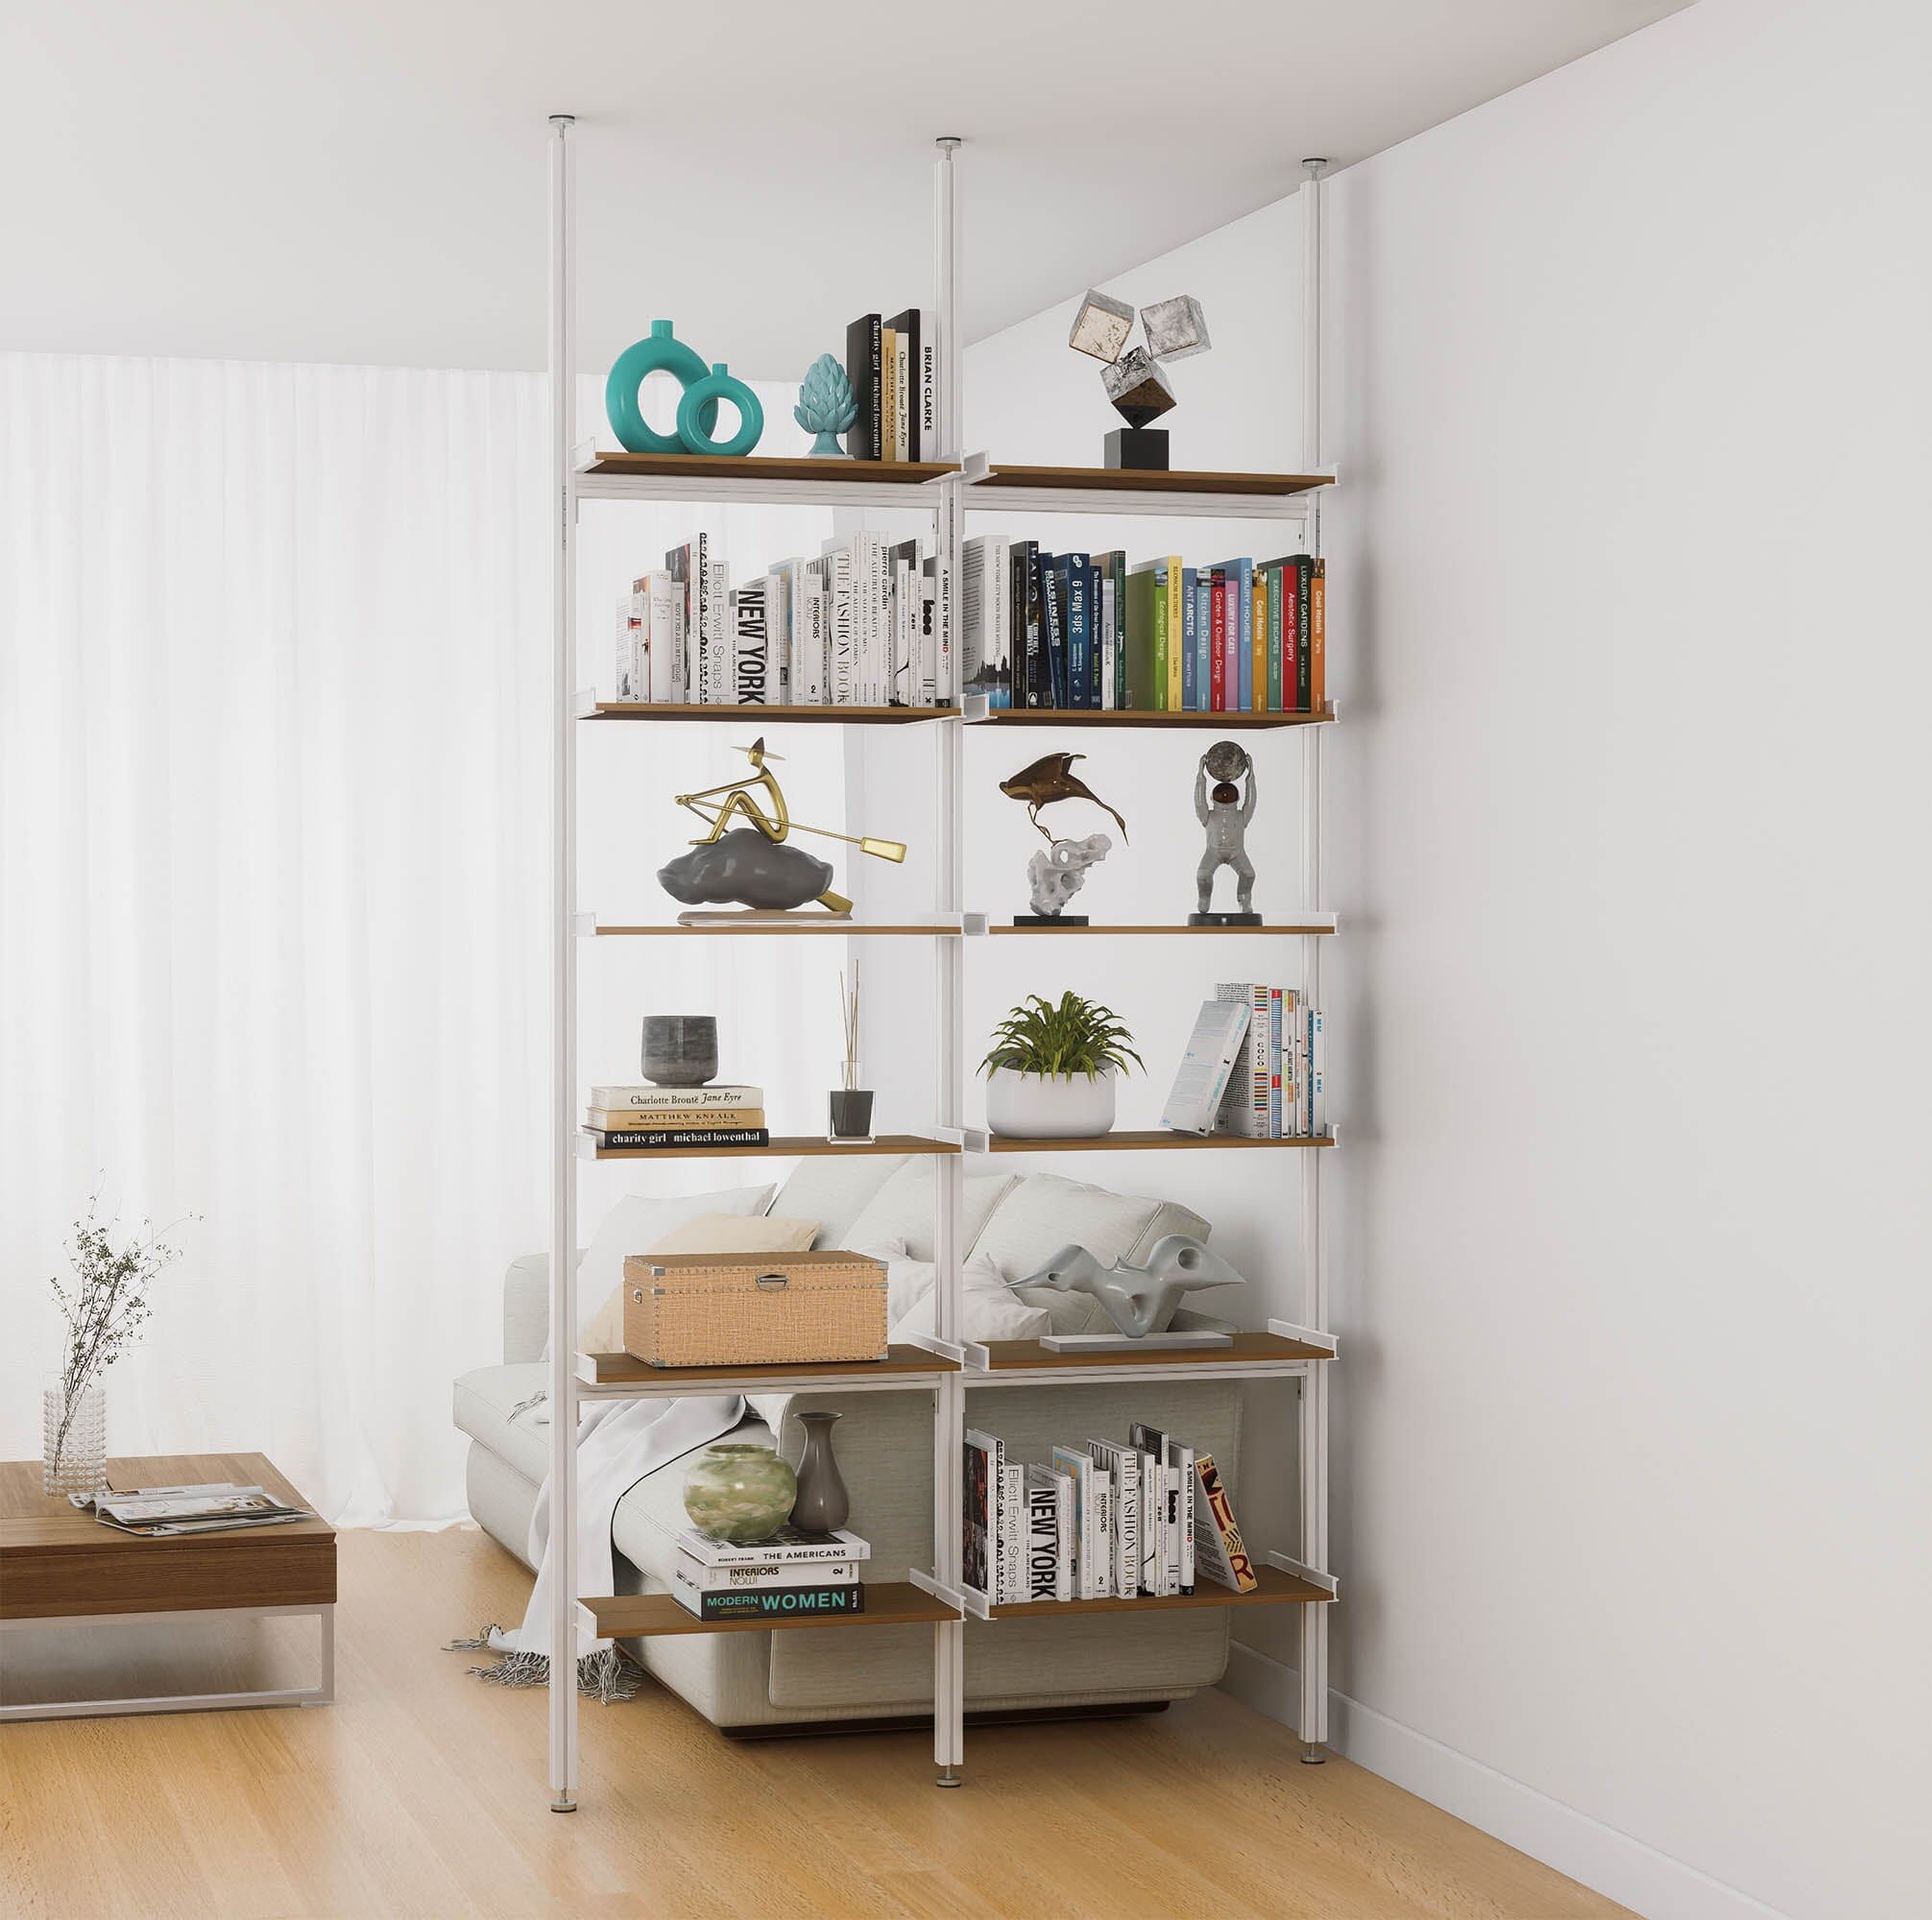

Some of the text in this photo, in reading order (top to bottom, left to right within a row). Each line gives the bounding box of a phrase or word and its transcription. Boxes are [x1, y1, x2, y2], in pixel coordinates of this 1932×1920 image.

[872, 593, 878, 603] OF
[943, 603, 949, 612] IN
[1049, 569, 1060, 647] BUSINESS
[1072, 589, 1083, 612] Max
[1214, 591, 1222, 616] Garden
[712, 564, 724, 690] Elliott Erwitt Snaps
[837, 553, 850, 705] THE FASHION BOOK
[1072, 614, 1083, 634] 3ds
[737, 590, 765, 705] NEW YORK
[1214, 627, 1222, 657] Outdoor
[1287, 629, 1295, 661] Surgery
[1214, 660, 1222, 684] Design
[810, 684, 816, 694] 2
[630, 1095, 669, 1105] Charlotte
[701, 1092, 722, 1104] Jane
[723, 1092, 741, 1104] Eyre
[612, 1133, 666, 1144] charity girl
[673, 1131, 761, 1142] michael lowenthal
[1008, 1469, 1020, 1588] Elliott Erwitt Snaps
[1123, 1453, 1135, 1596] THE FASHION BOOK
[785, 1549, 846, 1559] AMERICANS
[1031, 1490, 1056, 1599] NEW YORK
[730, 1567, 780, 1576] INTERIORS
[730, 1576, 758, 1586] NOW!
[1099, 1576, 1104, 1585] 2
[707, 1596, 759, 1607] MODERN
[761, 1592, 846, 1611] WOMEN
